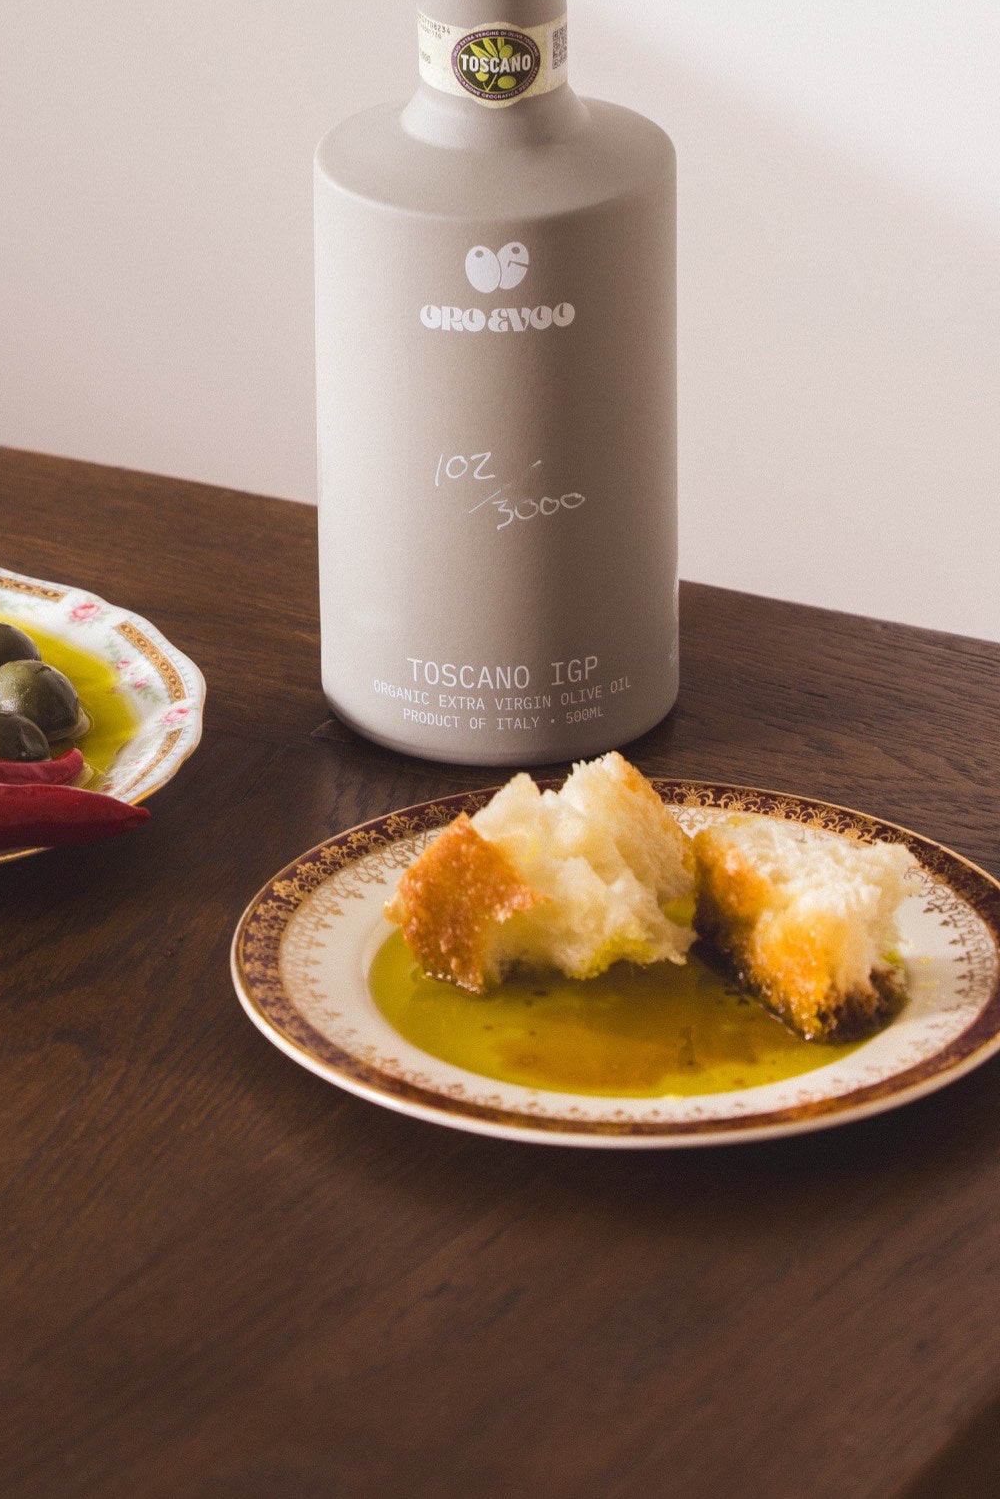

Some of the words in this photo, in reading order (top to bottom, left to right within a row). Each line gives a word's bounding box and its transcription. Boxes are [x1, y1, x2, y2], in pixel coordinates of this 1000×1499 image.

[460, 53, 532, 74] TOSCANO
[420, 304, 486, 332] ORO
[407, 657, 530, 689] TOSCANO
[550, 655, 598, 686] IGP
[373, 679, 430, 705] ORGANIC
[438, 695, 485, 711] EXTRA
[495, 695, 551, 711] VIRGIN
[561, 686, 602, 706] OLIVE
[610, 676, 632, 693] OIL
[403, 708, 459, 729] PRODUCT
[469, 717, 487, 730] OF
[496, 716, 540, 730] ITALY
[565, 706, 604, 724] 500ML
